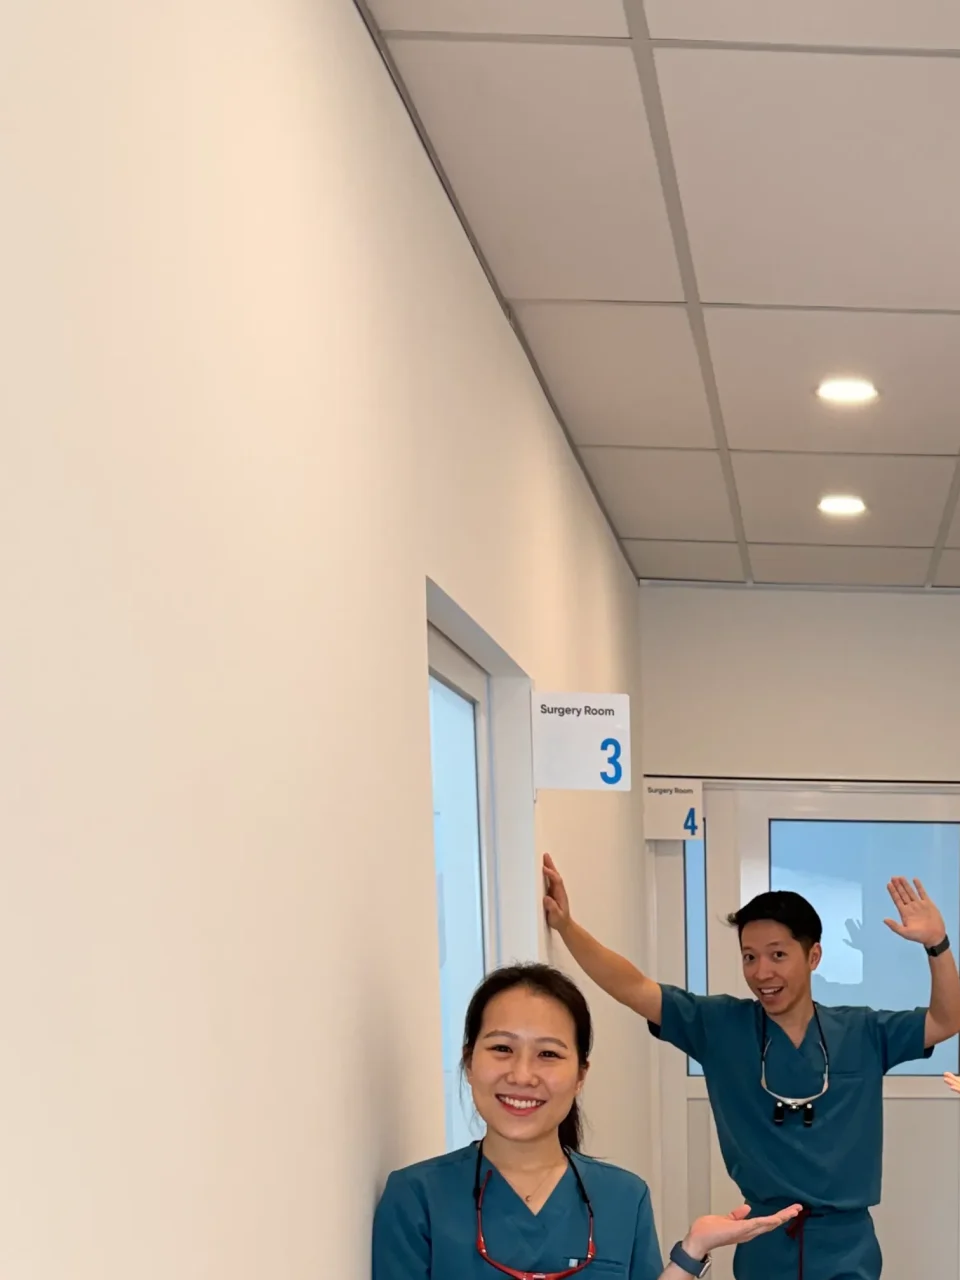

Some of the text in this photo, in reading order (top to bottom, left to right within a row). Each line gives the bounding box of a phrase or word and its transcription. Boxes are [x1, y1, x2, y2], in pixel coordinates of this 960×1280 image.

[540, 704, 615, 717] Surgery Room
[600, 737, 622, 785] 3
[647, 787, 673, 795] Surgery
[683, 807, 698, 836] 4
